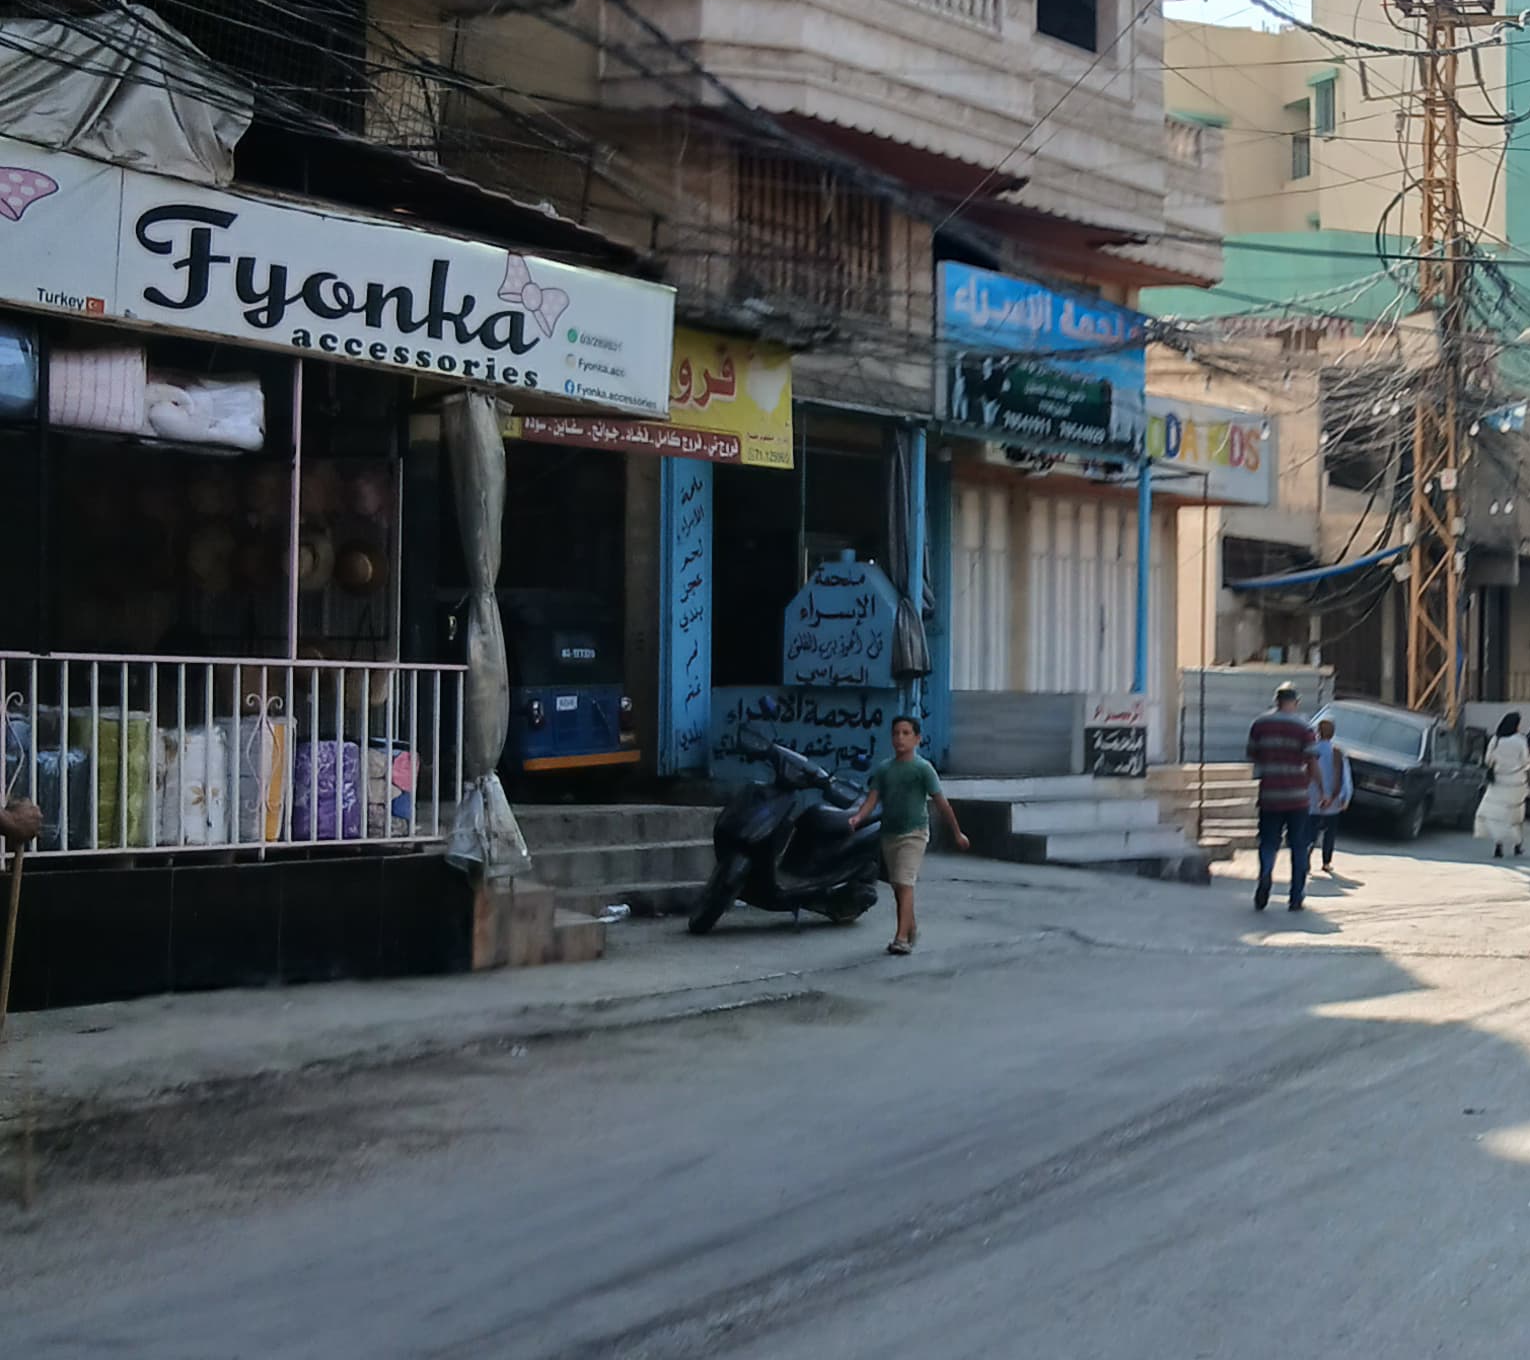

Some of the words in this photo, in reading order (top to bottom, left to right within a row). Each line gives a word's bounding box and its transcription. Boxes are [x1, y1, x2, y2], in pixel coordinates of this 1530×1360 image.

[37, 287, 84, 310] Turkey
[135, 203, 541, 355] Fyonka
[292, 328, 538, 388] accessories
[671, 344, 736, 405] فرو
